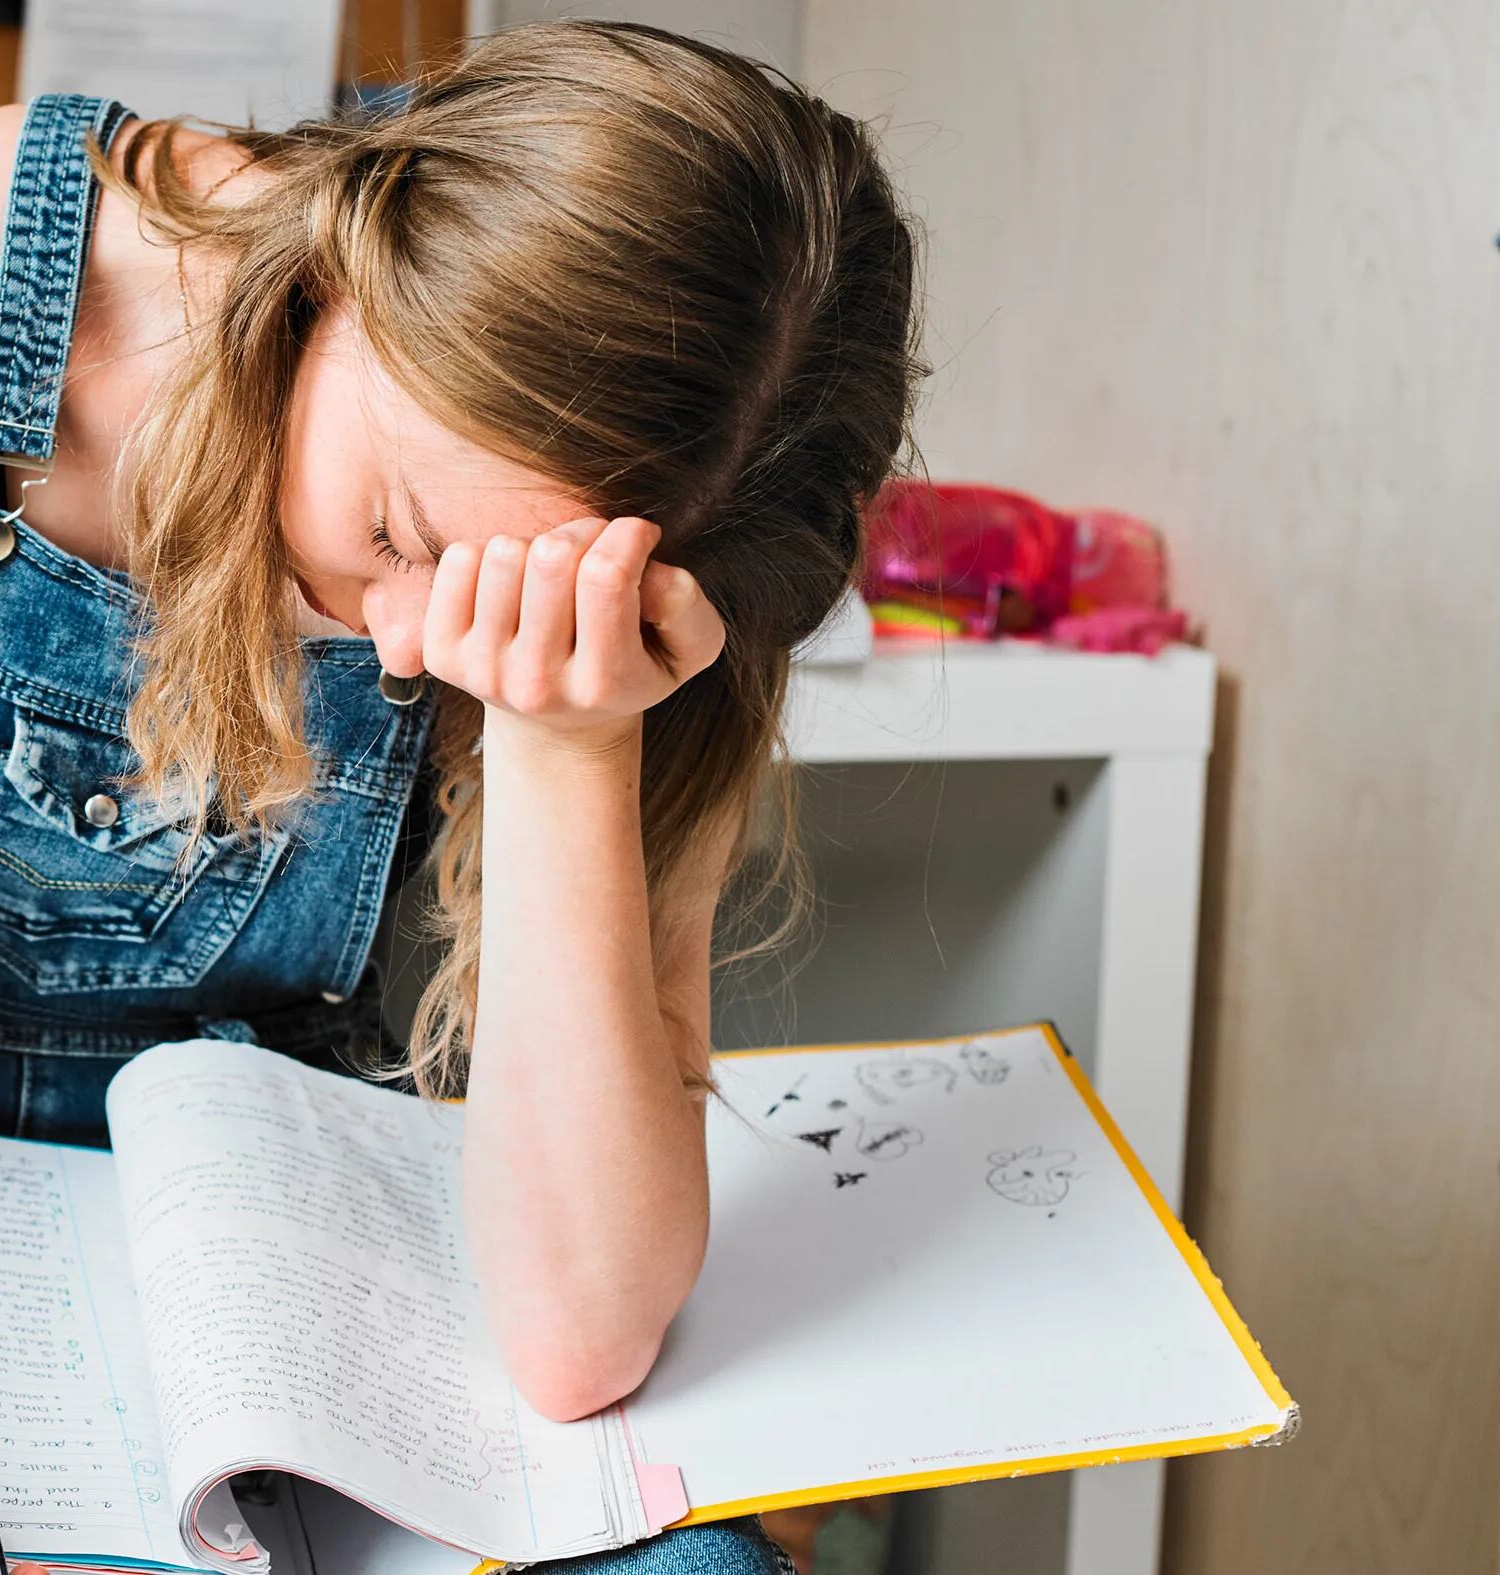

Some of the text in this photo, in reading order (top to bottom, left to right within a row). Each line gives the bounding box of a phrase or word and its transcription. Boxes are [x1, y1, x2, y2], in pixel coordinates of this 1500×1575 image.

[372, 1430, 416, 1456] down
[1, 1486, 28, 1495] the
[45, 1487, 80, 1495] and
